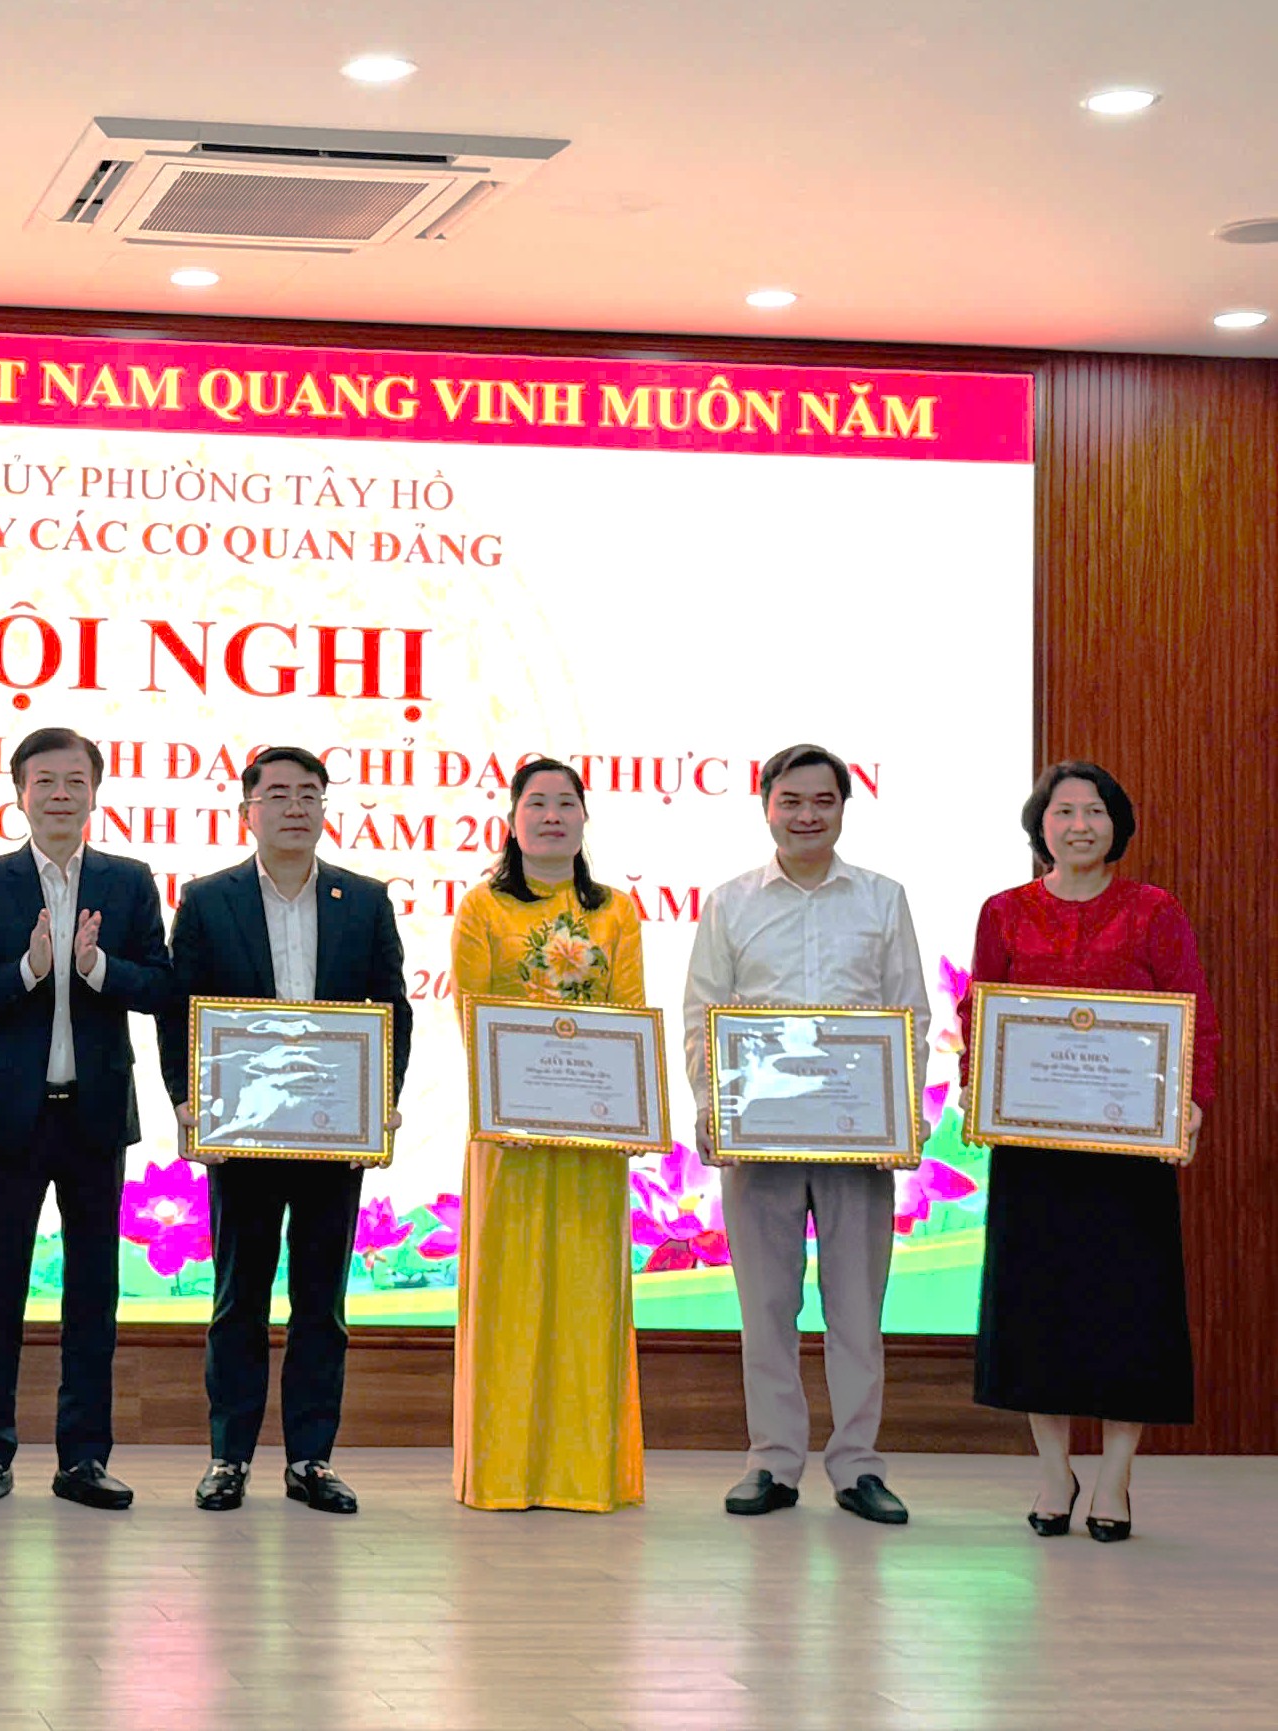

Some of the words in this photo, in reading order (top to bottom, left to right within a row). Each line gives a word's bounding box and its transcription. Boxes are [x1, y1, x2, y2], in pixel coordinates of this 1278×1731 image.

[40, 362, 183, 410] NAM
[198, 369, 418, 421] QUANG
[431, 379, 584, 426] VINH
[598, 375, 782, 433] MUÔN
[797, 382, 936, 438] NĂM
[4, 454, 66, 496] ỦY
[81, 460, 271, 504] PHƯỜNG
[285, 466, 377, 508] TÂY
[391, 470, 454, 511] HỒ
[29, 509, 128, 553] CÁC
[142, 522, 211, 557] CƠ
[224, 526, 355, 564] QUAN
[369, 523, 503, 567] ĐẢNG
[140, 620, 432, 723] NGHỊ
[164, 741, 270, 793] ĐẠ
[434, 750, 547, 800] ĐẠ
[570, 752, 728, 803] THỰC
[627, 874, 701, 922] ĂM
